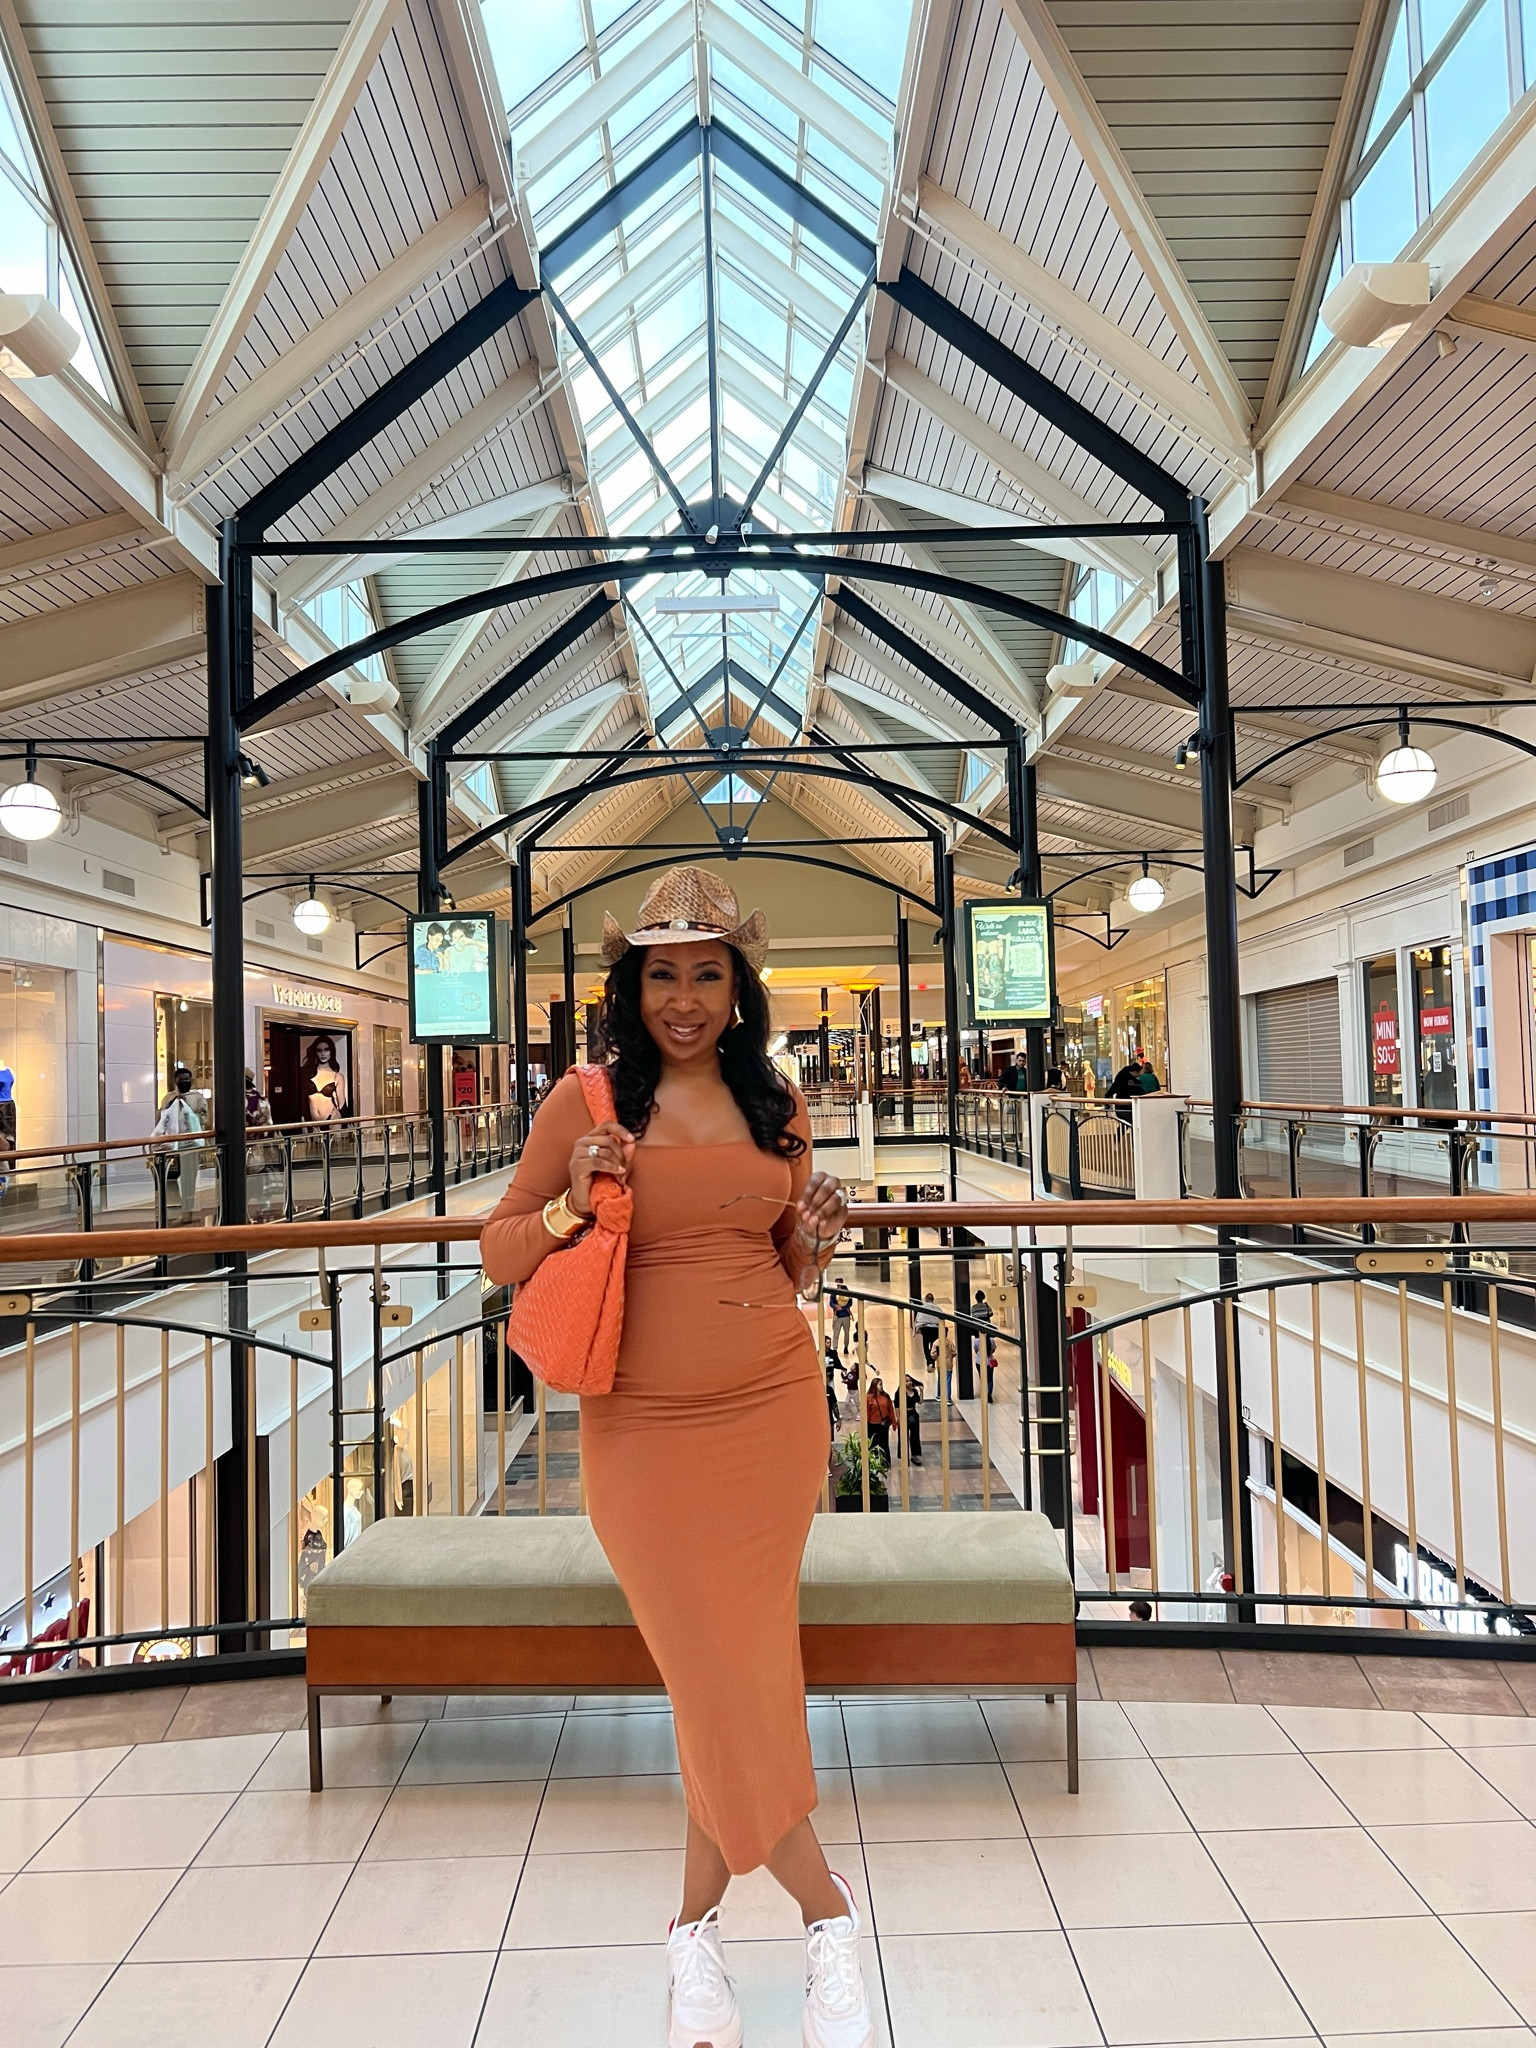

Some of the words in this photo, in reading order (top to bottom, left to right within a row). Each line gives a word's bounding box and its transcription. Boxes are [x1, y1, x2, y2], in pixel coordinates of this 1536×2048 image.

[1423, 1016, 1433, 1028] NOW
[1433, 1015, 1449, 1026] HIRING
[1376, 1021, 1395, 1040] MINI
